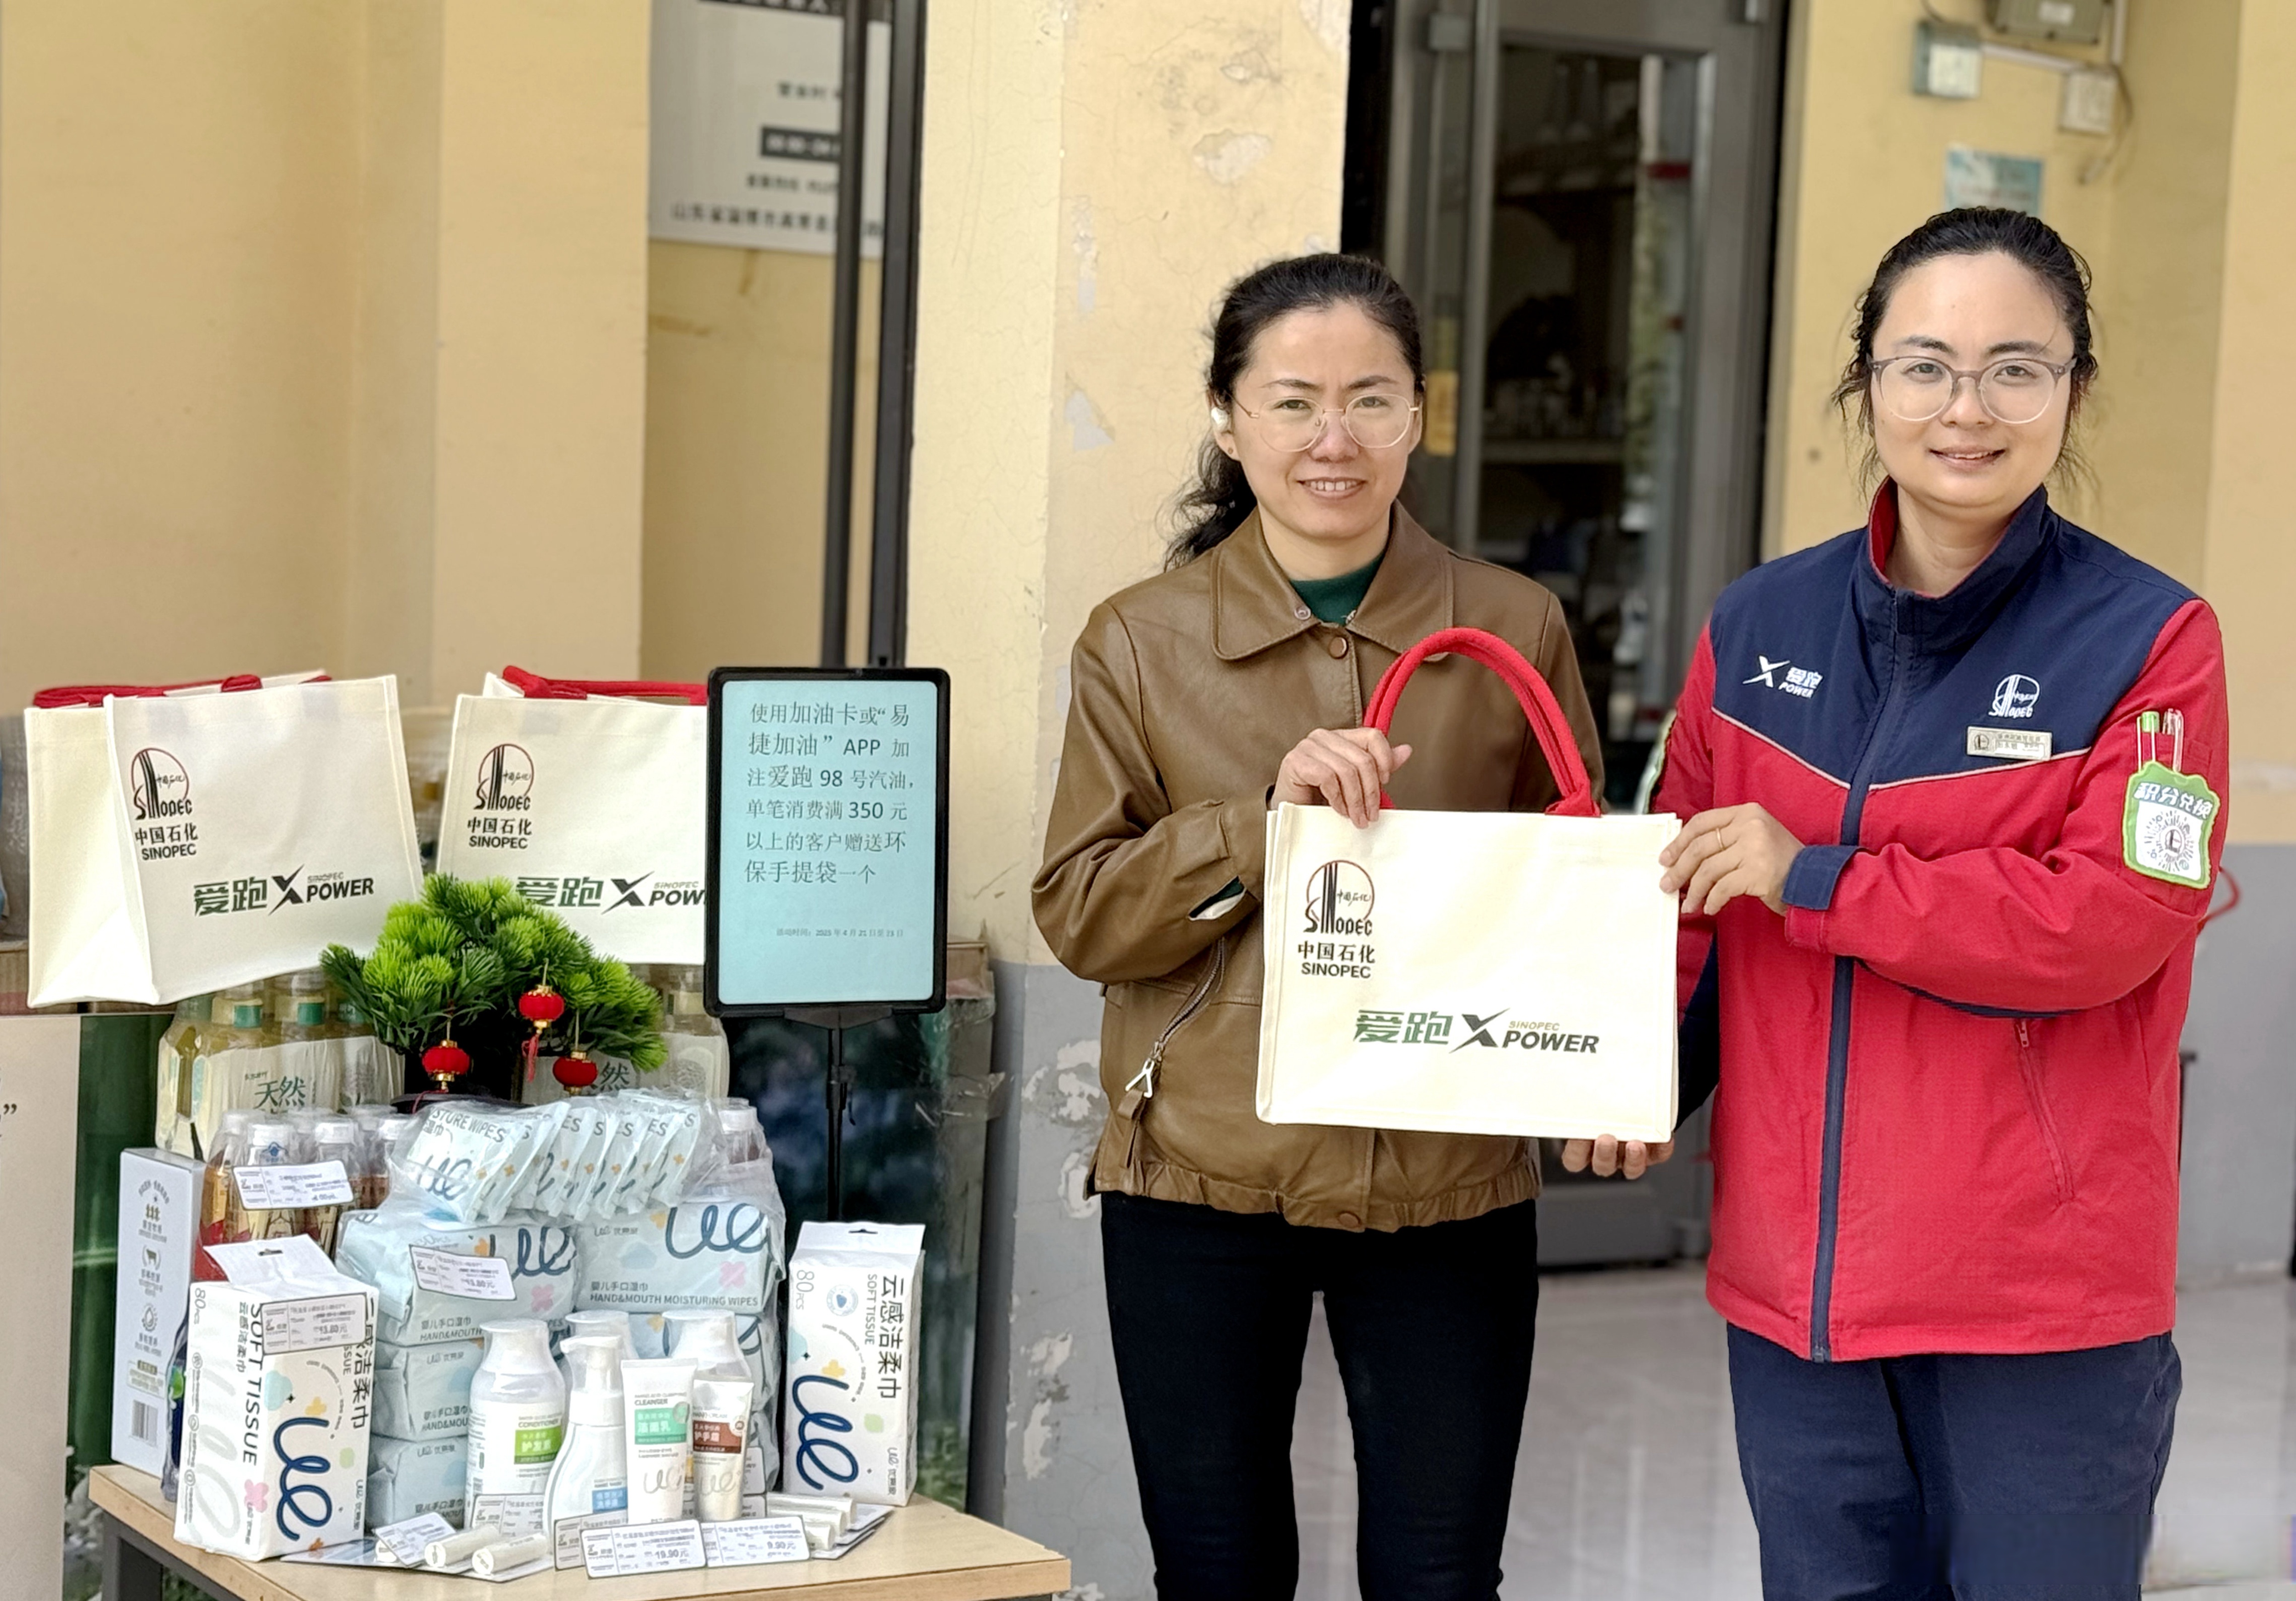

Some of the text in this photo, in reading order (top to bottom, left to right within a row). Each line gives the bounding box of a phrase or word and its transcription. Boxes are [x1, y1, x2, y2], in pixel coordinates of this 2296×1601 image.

[1778, 682, 1814, 698] POWER
[843, 739, 881, 756] APP
[891, 738, 910, 758] 加
[747, 764, 813, 789] 注爱跑
[820, 770, 843, 787] 98
[746, 799, 908, 821] 单笔消费满 350 元
[2133, 782, 2214, 820] 积分兑换
[135, 823, 198, 846] 中国石化
[467, 816, 532, 836] 中国石化
[141, 843, 197, 861] SINOPEC
[469, 835, 529, 850] SINOPEC
[746, 829, 906, 854] 以上的客户赠送环
[744, 858, 877, 885] 保手提袋一个
[193, 877, 268, 917] 爱跑
[306, 878, 374, 903] POWER
[1298, 941, 1375, 964] 中国石化
[1301, 962, 1371, 979] SINOPEC
[1353, 1009, 1453, 1045] 爱跑
[1502, 1030, 1600, 1054] POWER
[1508, 1020, 1560, 1032] SINOPEC
[253, 1075, 306, 1110] 天然
[590, 1293, 758, 1307] HAND&MOUTH MOISTURING WIPES
[864, 1274, 878, 1346] SOFT TISSUE
[877, 1274, 905, 1399] 云感洁柔巾
[243, 1376, 263, 1466] TISSUE
